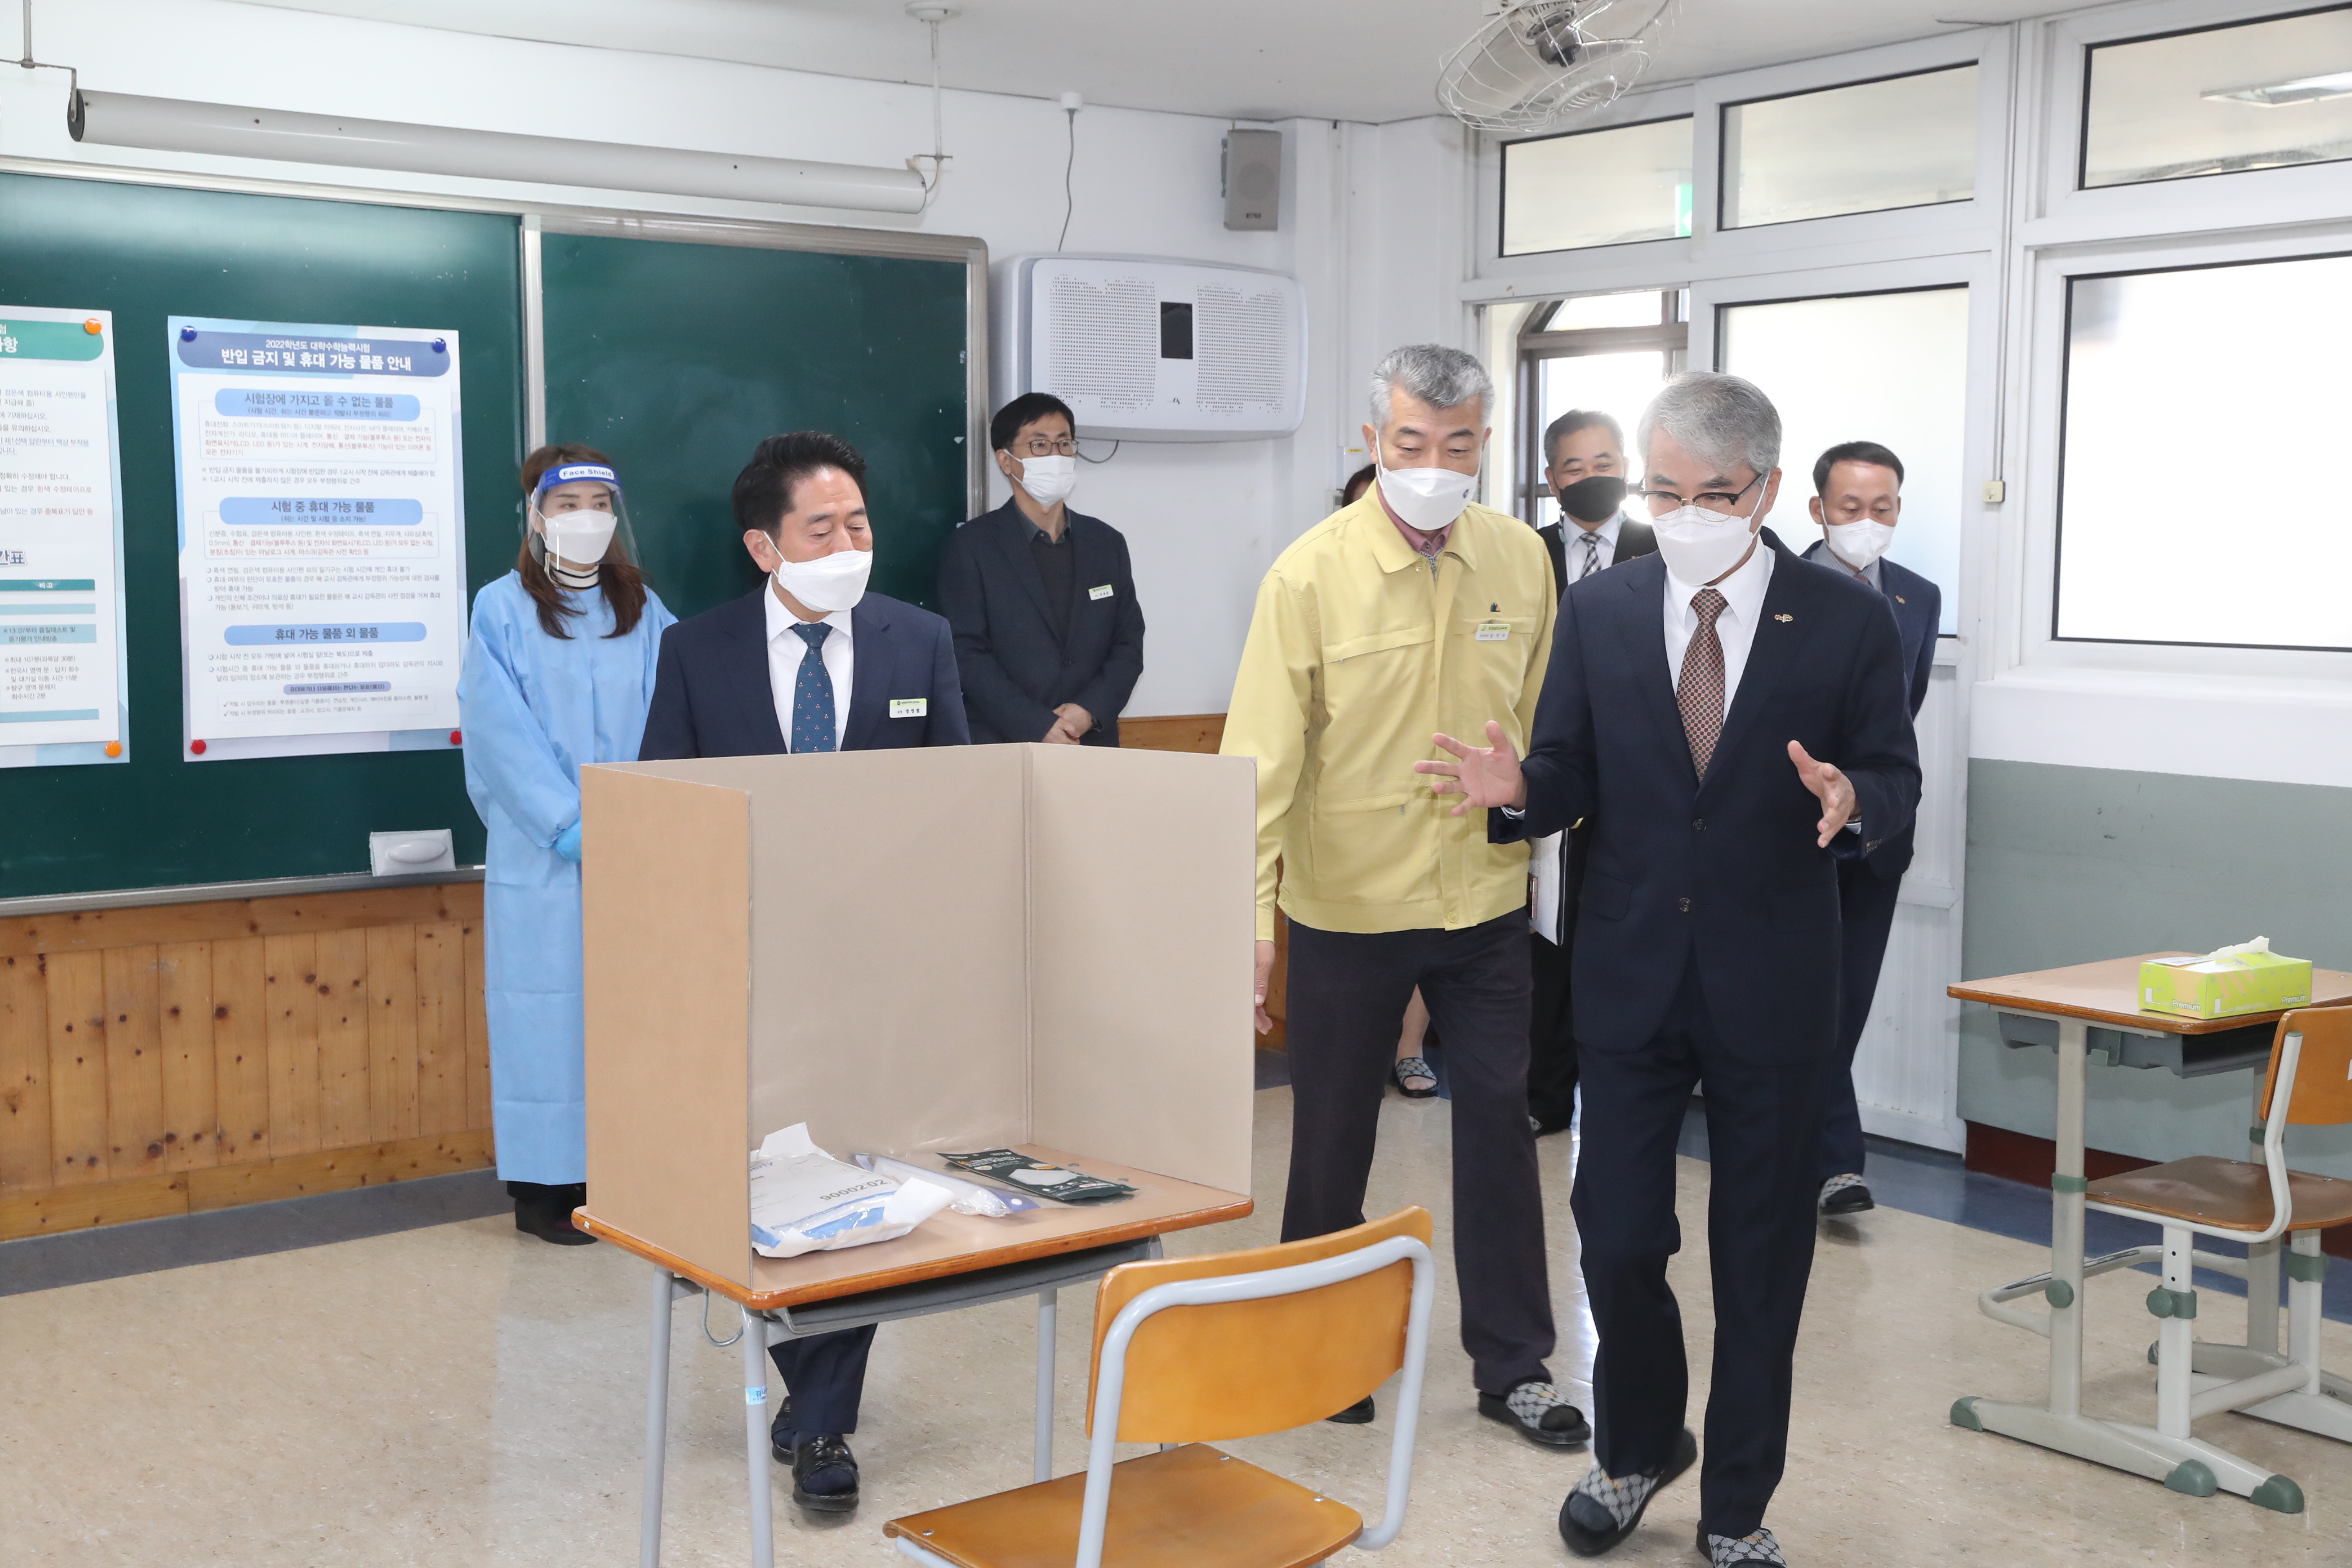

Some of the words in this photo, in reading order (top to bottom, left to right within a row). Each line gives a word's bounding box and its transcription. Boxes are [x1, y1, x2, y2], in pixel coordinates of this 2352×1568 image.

[266, 338, 308, 351] 2022학년도
[309, 340, 370, 353] 대학수학능력시험
[221, 348, 248, 365] 반입
[252, 349, 279, 366] 금지
[282, 351, 295, 367] 및
[300, 351, 326, 368] 휴대
[329, 353, 355, 369] 가능
[359, 354, 383, 370] 물품
[387, 355, 411, 371] 안내
[244, 392, 286, 406] 시험장에
[289, 394, 319, 406] 가지고
[324, 395, 333, 407] 올
[337, 395, 348, 407] 수
[351, 396, 371, 408] 없는
[375, 397, 393, 409] 물품
[587, 469, 612, 477] Shield
[272, 500, 291, 513] 시험
[295, 500, 305, 513] 중
[309, 500, 329, 513] 휴대
[332, 501, 351, 513] 가능
[355, 501, 375, 513] 물품
[275, 628, 295, 641] 휴대
[299, 628, 318, 640] 가능
[322, 627, 342, 640] 물품
[346, 627, 355, 639] 외
[359, 627, 378, 639] 물품
[2172, 999, 2201, 1012] Premium
[2282, 995, 2306, 1004] Premium
